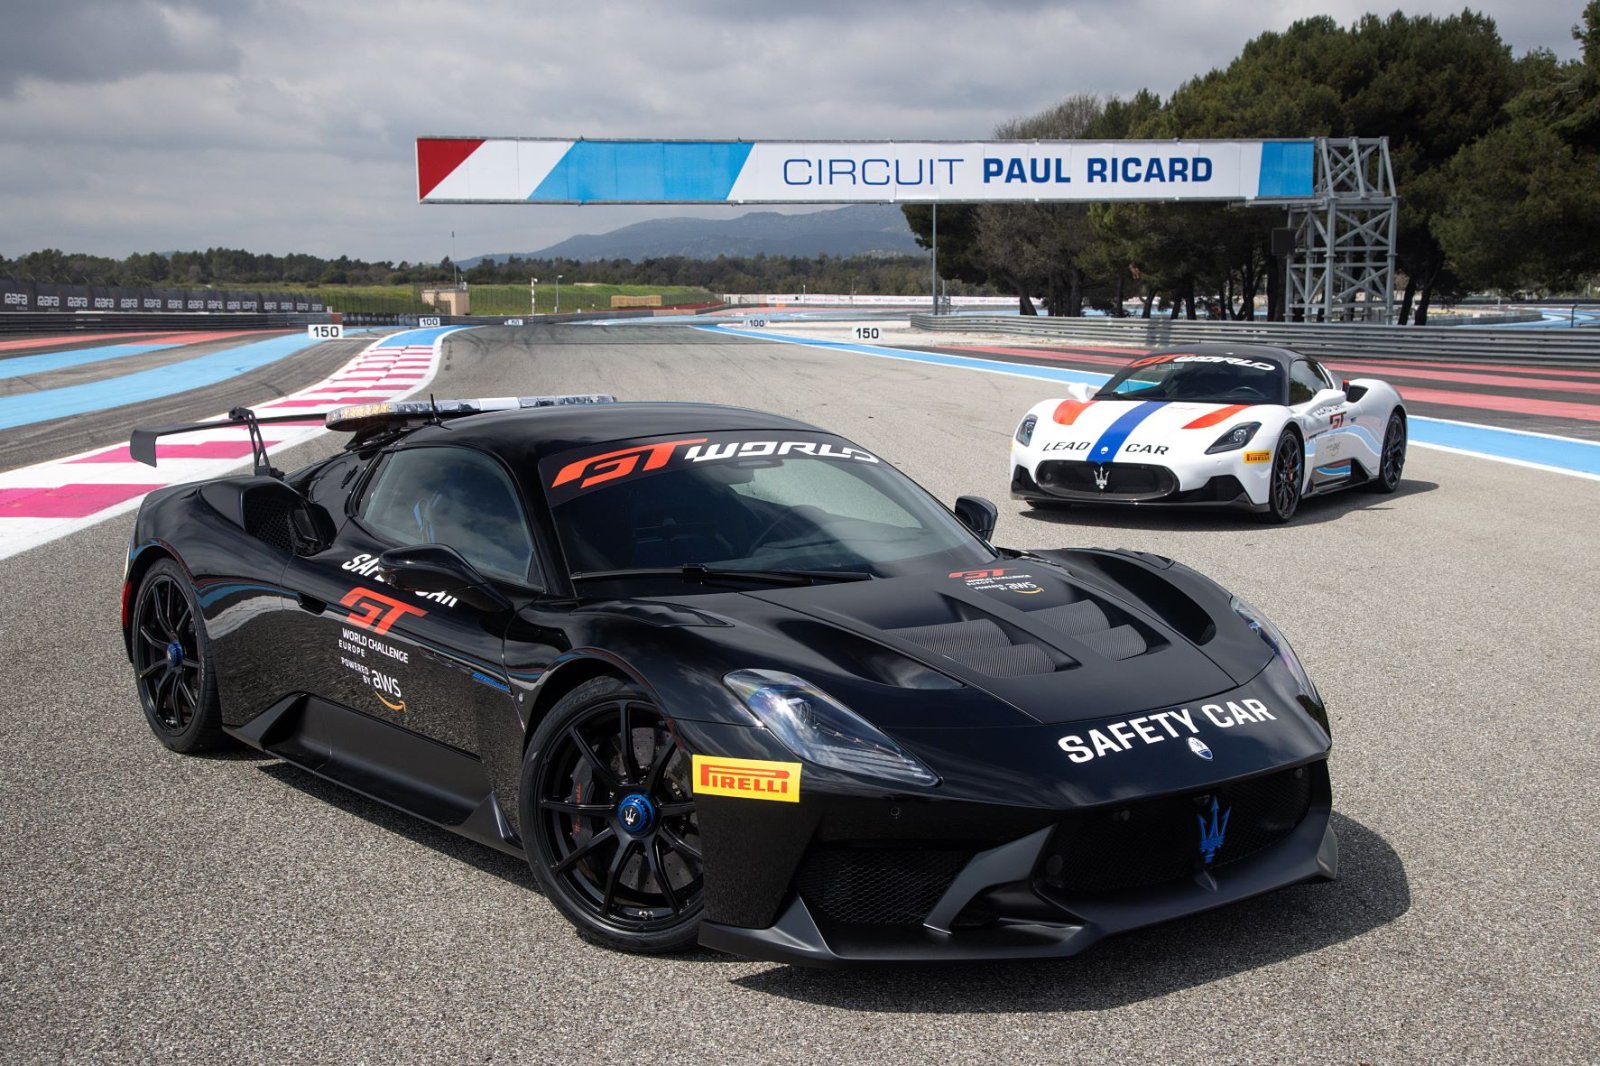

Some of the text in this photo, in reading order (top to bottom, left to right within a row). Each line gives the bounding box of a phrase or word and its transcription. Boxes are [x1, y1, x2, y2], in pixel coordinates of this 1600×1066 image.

[783, 157, 1213, 185] CIRCUIT PAUL RICARD
[422, 317, 439, 326] 100
[749, 319, 765, 328] 100
[313, 326, 339, 338] 150
[855, 327, 879, 339] 150
[1173, 355, 1276, 372] WORLD
[684, 440, 880, 464] WORLD
[1042, 441, 1169, 455] LEAD CAR
[338, 586, 430, 636] GT
[338, 639, 366, 658] EUROPE
[342, 627, 409, 664] WORLD CHALLENGE
[340, 656, 369, 676] POWERED
[362, 675, 371, 685] BY
[371, 669, 402, 698] aws
[1057, 698, 1277, 763] SAFETY CAR
[700, 763, 790, 794] PIRELLI
